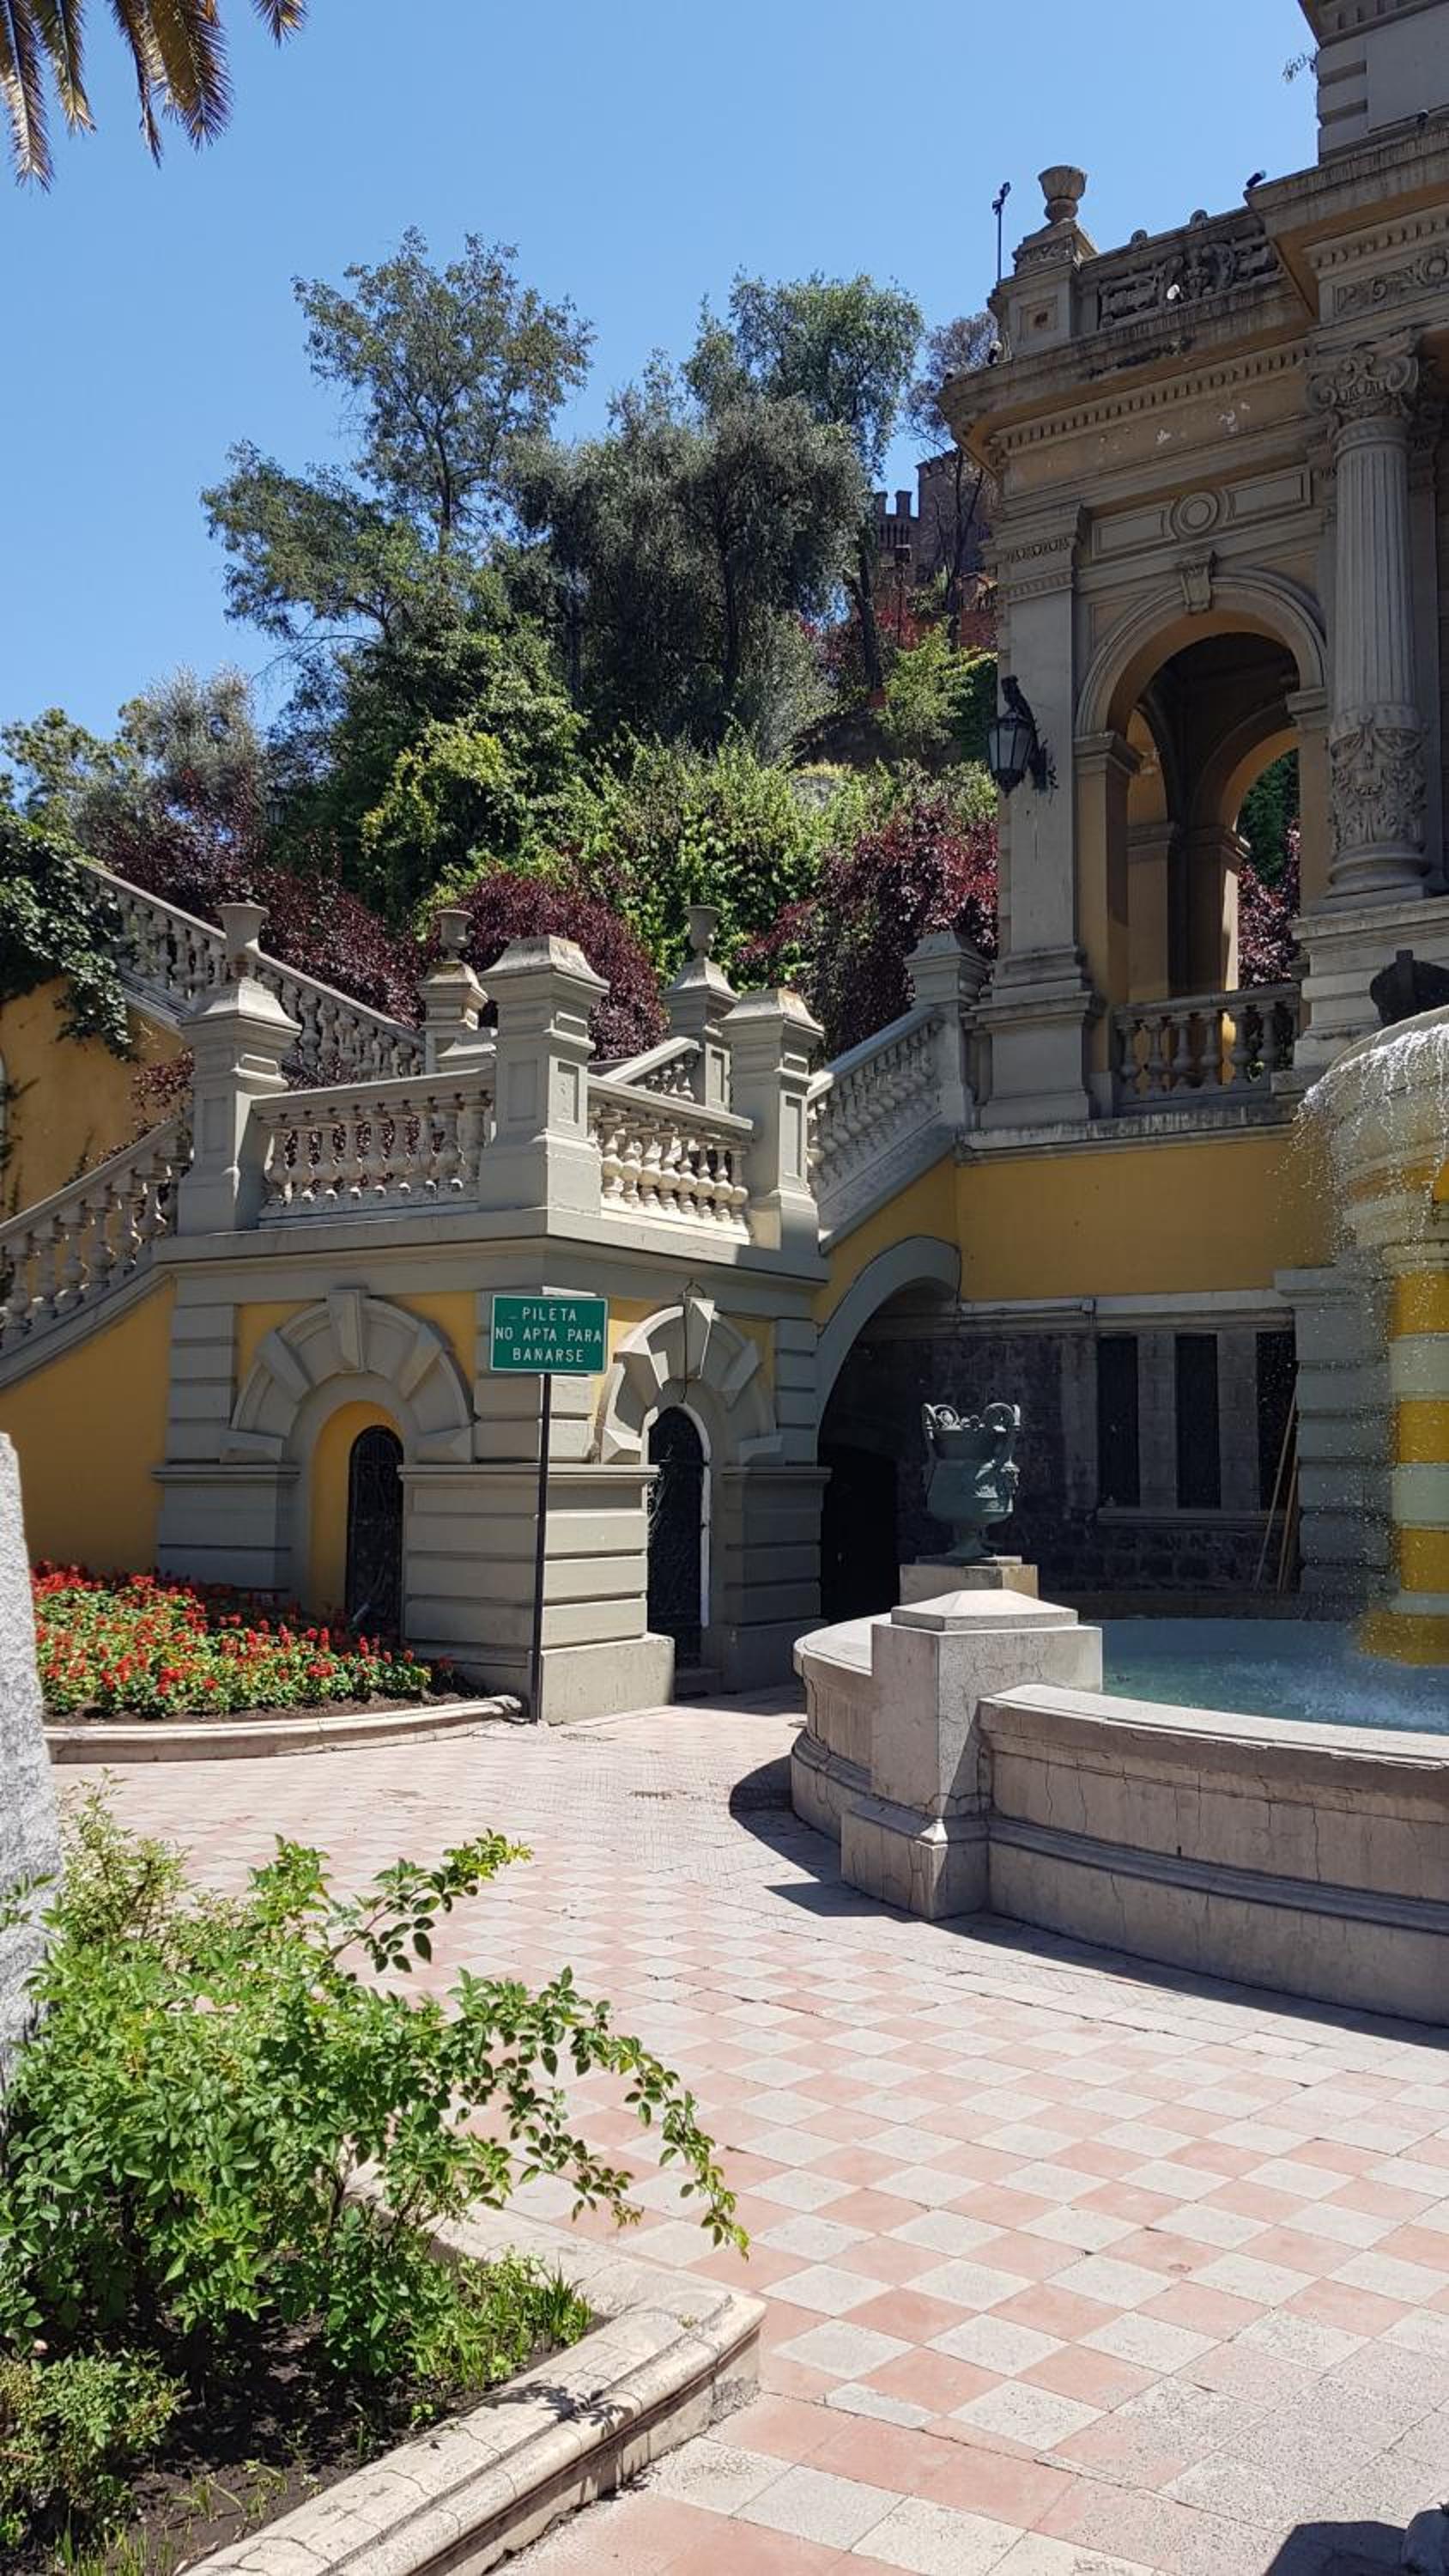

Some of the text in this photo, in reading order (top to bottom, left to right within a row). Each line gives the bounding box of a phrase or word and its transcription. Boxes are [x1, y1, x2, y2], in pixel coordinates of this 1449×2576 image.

[522, 1306, 577, 1321] PILETA
[495, 1326, 602, 1343] NO APTA PARA
